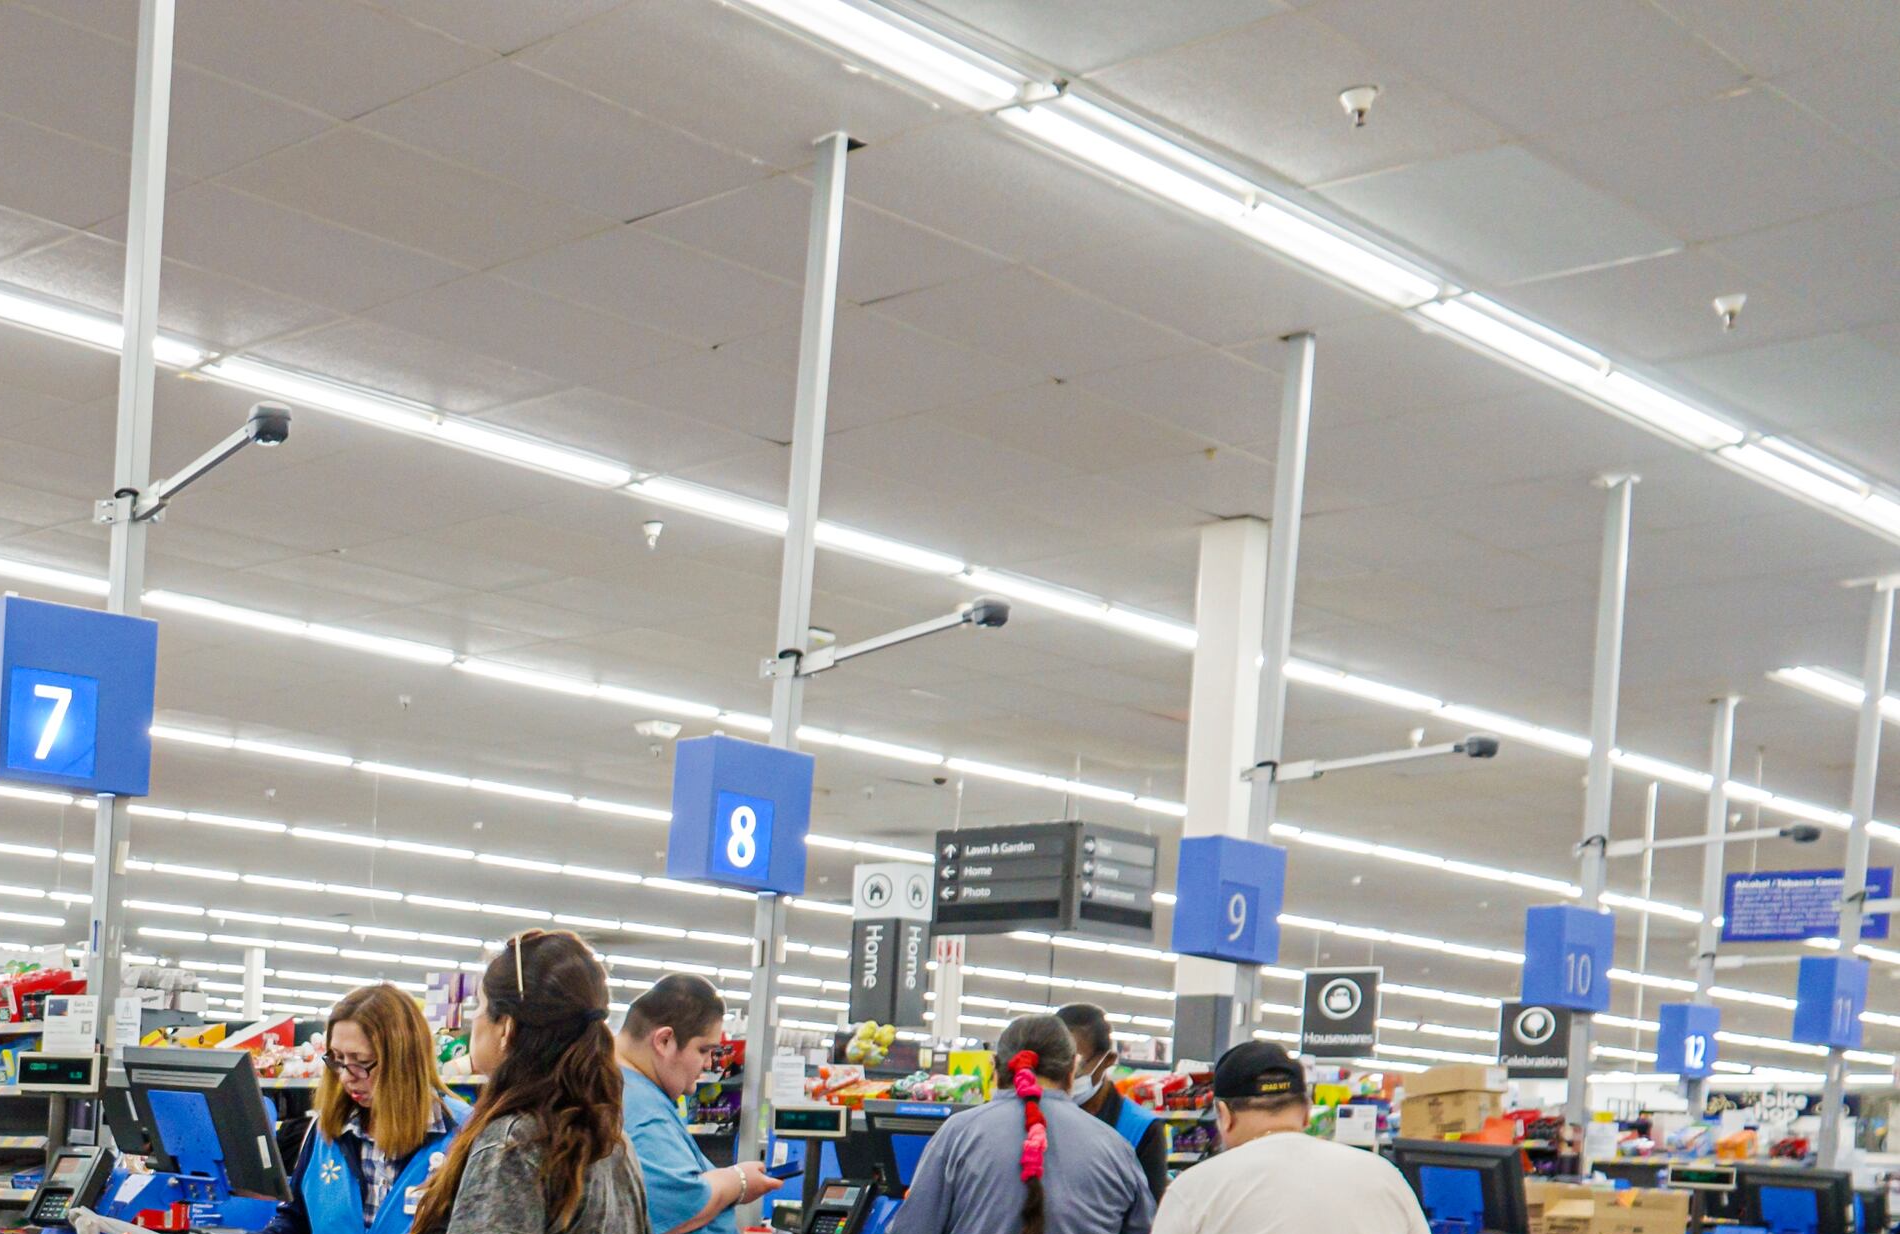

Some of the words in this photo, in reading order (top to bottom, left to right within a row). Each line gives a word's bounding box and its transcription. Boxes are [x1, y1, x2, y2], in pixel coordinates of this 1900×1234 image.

[34, 684, 72, 760] 7
[727, 805, 757, 869] 8
[965, 844, 990, 855] Lawn
[991, 844, 1000, 854] &
[1001, 840, 1035, 853] Garden
[963, 866, 993, 877] Home
[962, 886, 991, 898] Photo
[1227, 892, 1247, 941] 9
[863, 924, 883, 990] Home
[905, 925, 922, 990] Home
[1567, 952, 1592, 997] 10
[1834, 996, 1852, 1035] 11
[1304, 1032, 1374, 1046] Housewares
[1684, 1034, 1707, 1070] 12
[1501, 1053, 1568, 1068] Celebrations
